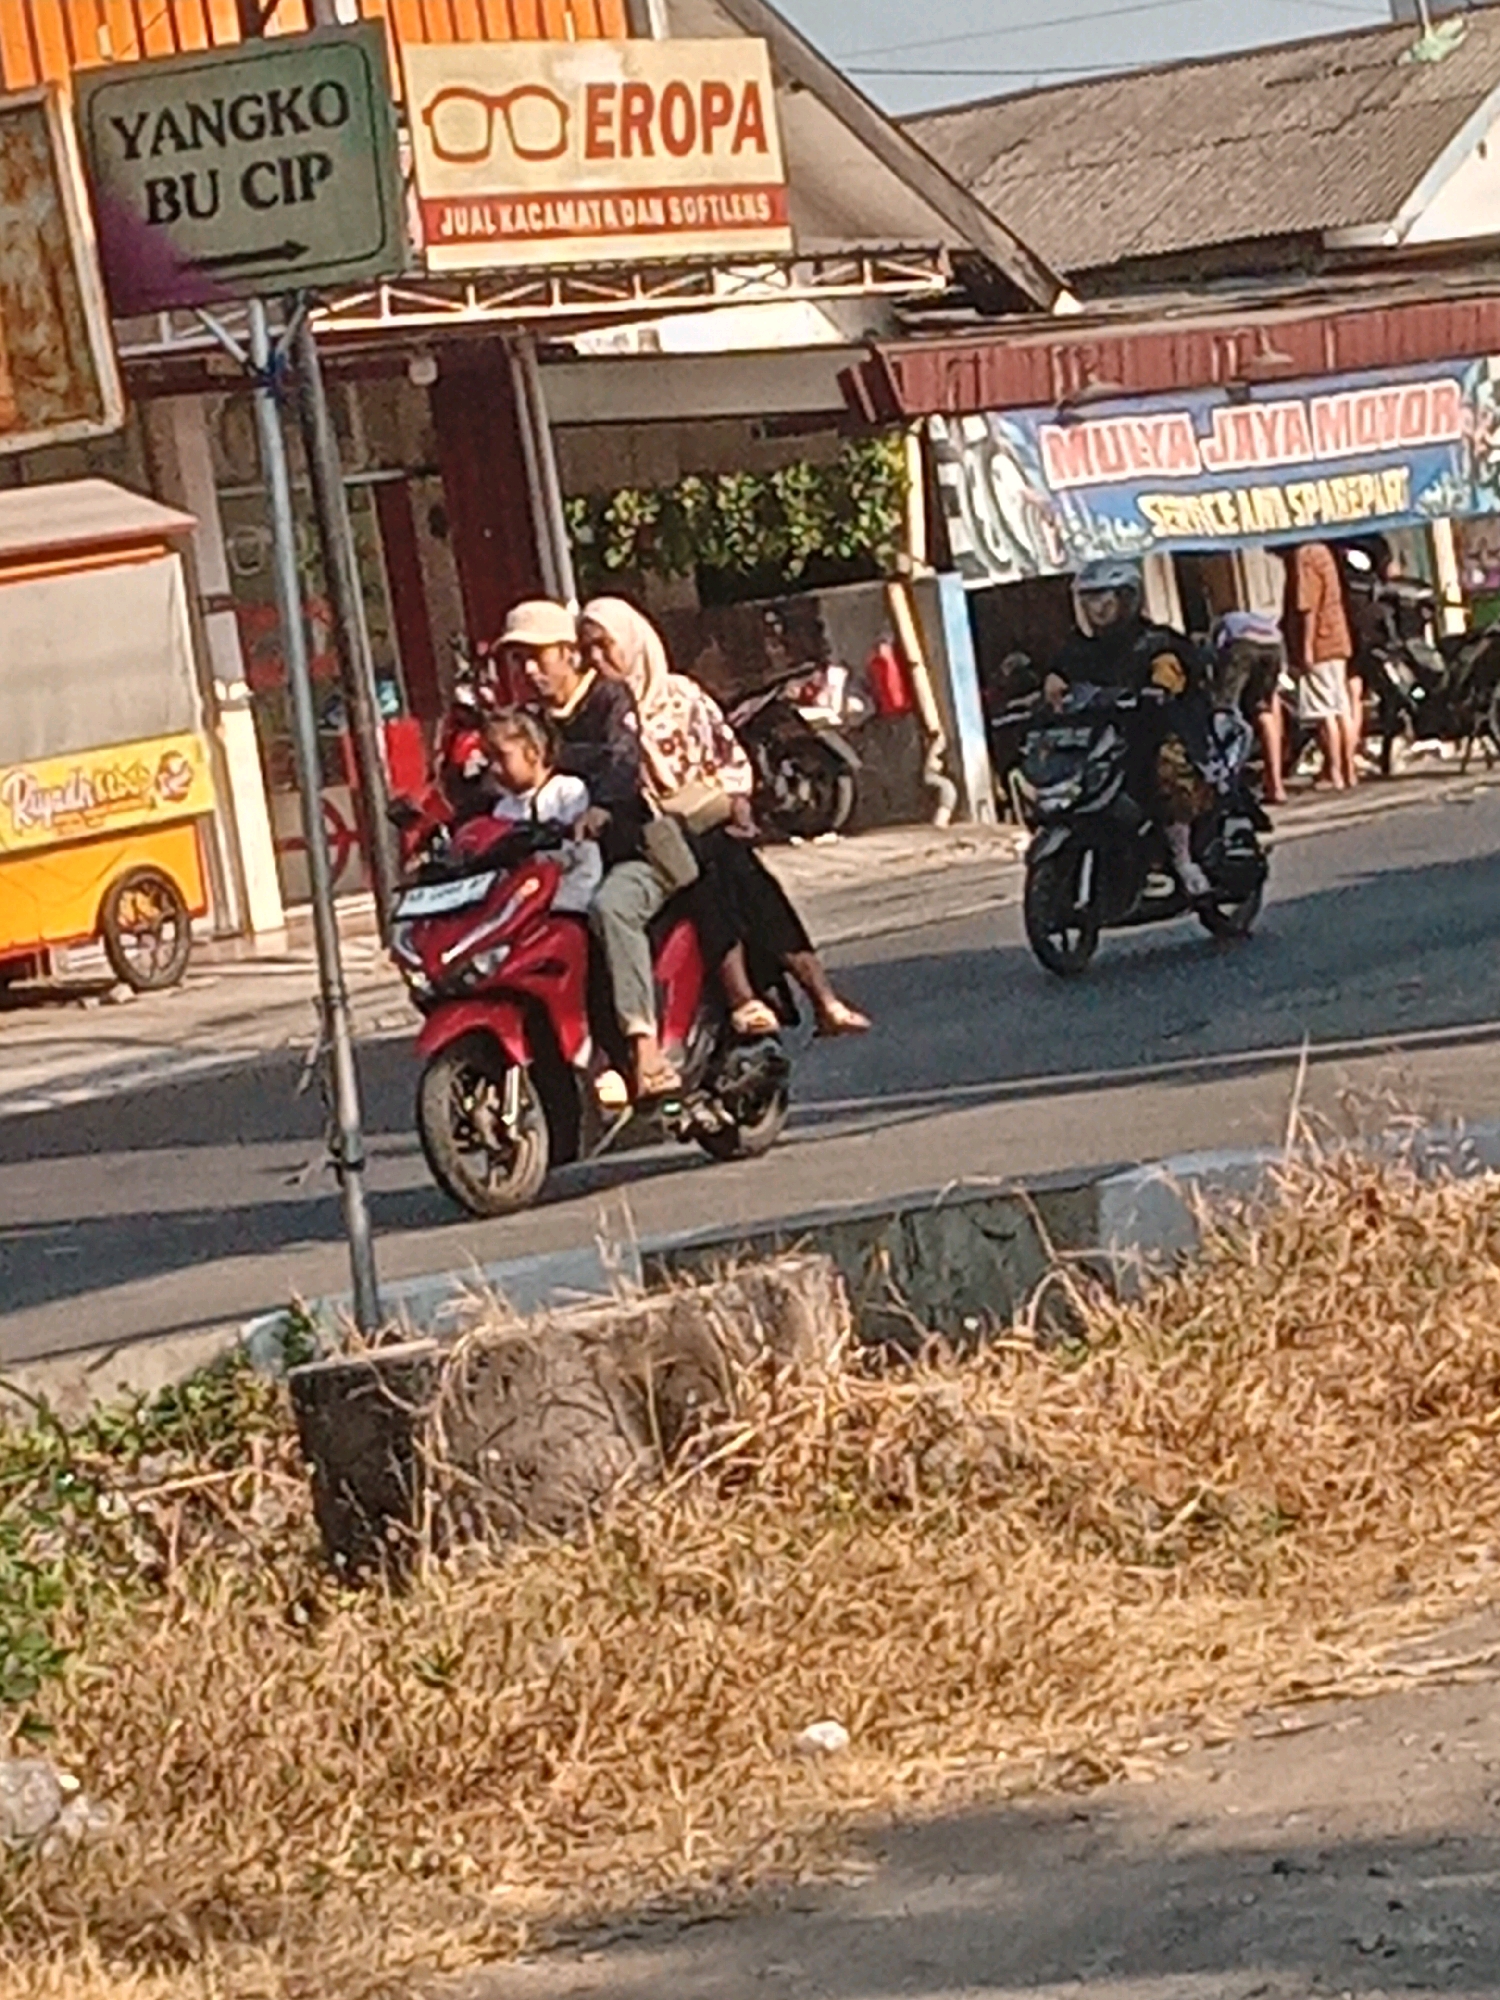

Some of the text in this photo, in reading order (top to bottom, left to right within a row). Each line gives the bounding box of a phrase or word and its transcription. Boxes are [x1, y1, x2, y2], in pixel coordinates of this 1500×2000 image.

[109, 80, 350, 160] YANGKO
[584, 80, 769, 160] EROPA
[144, 152, 334, 226] BU CIP
[440, 192, 771, 236] JUAL KACAMATA DAN SOFTLENS
[1041, 380, 1462, 488] MULYA JAYA MOTOR
[1138, 490, 1240, 537] SERVICE
